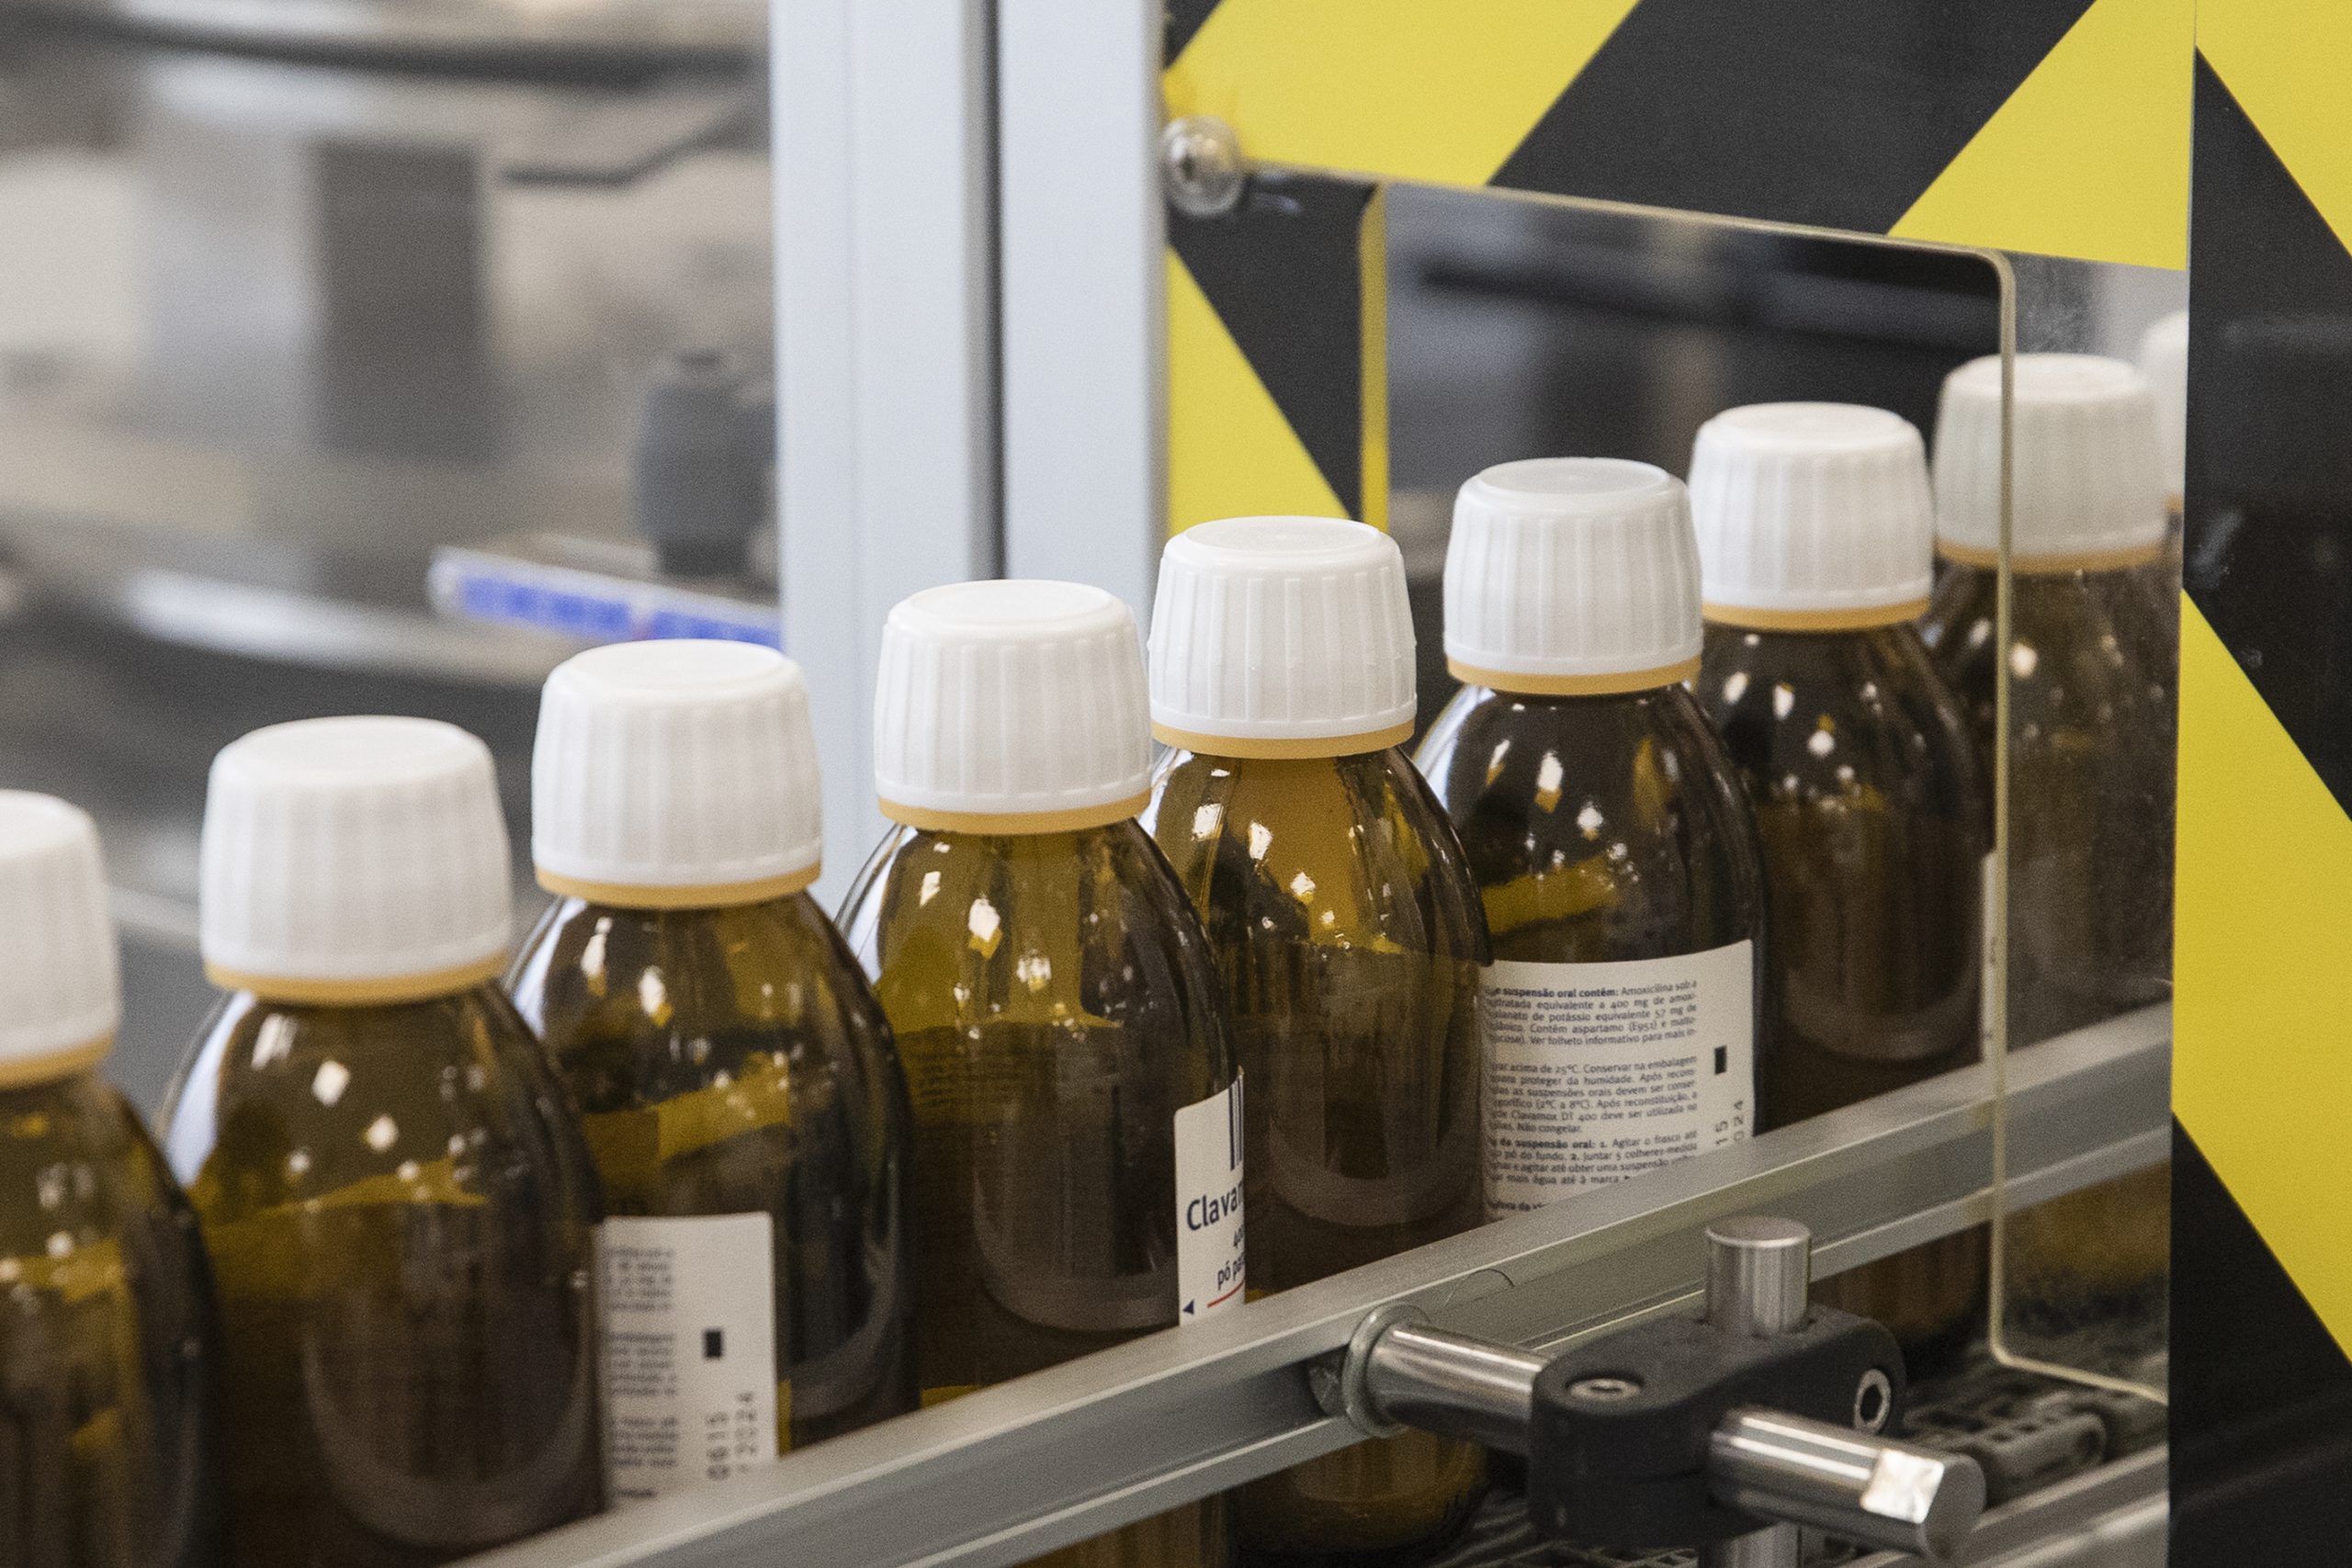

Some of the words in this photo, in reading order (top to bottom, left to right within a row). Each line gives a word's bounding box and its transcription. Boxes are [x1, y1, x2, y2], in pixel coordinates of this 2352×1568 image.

[1503, 987, 1555, 998] suspensão
[1557, 987, 1577, 998] oral
[1578, 987, 1619, 998] contém:
[1621, 983, 1673, 996] Amoxicilina
[1675, 980, 1690, 990] sob
[1536, 999, 1594, 1010] equivalente
[1610, 1000, 1629, 1010] 400
[1634, 999, 1648, 1009] mg
[1653, 996, 1665, 1005] de
[1532, 1011, 1544, 1021] de
[1549, 1012, 1591, 1023] potássio
[1595, 1010, 1650, 1021] equivalente
[1655, 1009, 1666, 1019] 57
[1670, 1007, 1683, 1016] mg
[1687, 1004, 1697, 1012] de
[1530, 1023, 1567, 1033] Contém
[1572, 1024, 1624, 1035] aspartamo
[1530, 1035, 1546, 1044] Ver
[1547, 1035, 1584, 1045] folheto
[1585, 1035, 1640, 1045] informativo
[1642, 1033, 1663, 1043] para
[1665, 1030, 1685, 1039] mais
[1510, 1063, 1538, 1073] acima
[1540, 1064, 1552, 1073] de
[1583, 1064, 1632, 1073] Conservar
[1647, 1055, 1697, 1068] embalagem
[1521, 1076, 1562, 1087] proteger
[1566, 1077, 1578, 1085] da
[1639, 1073, 1662, 1083] Após
[1512, 1088, 1523, 1096] as
[1527, 1087, 1585, 1098] suspensões
[1589, 1088, 1611, 1097] orais
[1615, 1086, 1646, 1096] devem
[1650, 1085, 1664, 1093] ser
[1597, 1099, 1621, 1109] Após
[1511, 1111, 1557, 1121] Clavamox
[1561, 1112, 1573, 1121] DT
[1578, 1112, 1598, 1122] 400
[1600, 1111, 1623, 1120] deve
[1628, 1111, 1642, 1119] ser
[1517, 1122, 1537, 1132] Não
[1499, 1137, 1511, 1146] da
[1515, 1138, 1568, 1148] suspensão
[1612, 1138, 1641, 1149] Agitar
[1654, 1134, 1680, 1145] frasco
[1505, 1150, 1517, 1159] pó
[1520, 1151, 1532, 1159] do
[1521, 1164, 1549, 1174] agitar
[1551, 1163, 1566, 1172] até
[1568, 1163, 1594, 1172] obter
[1597, 1164, 1618, 1172] uma
[1620, 1158, 1668, 1170] suspensão
[1507, 1174, 1529, 1183] mais
[1532, 1174, 1557, 1186] água
[1561, 1175, 1576, 1184] até
[1217, 1259, 1231, 1292] pó
